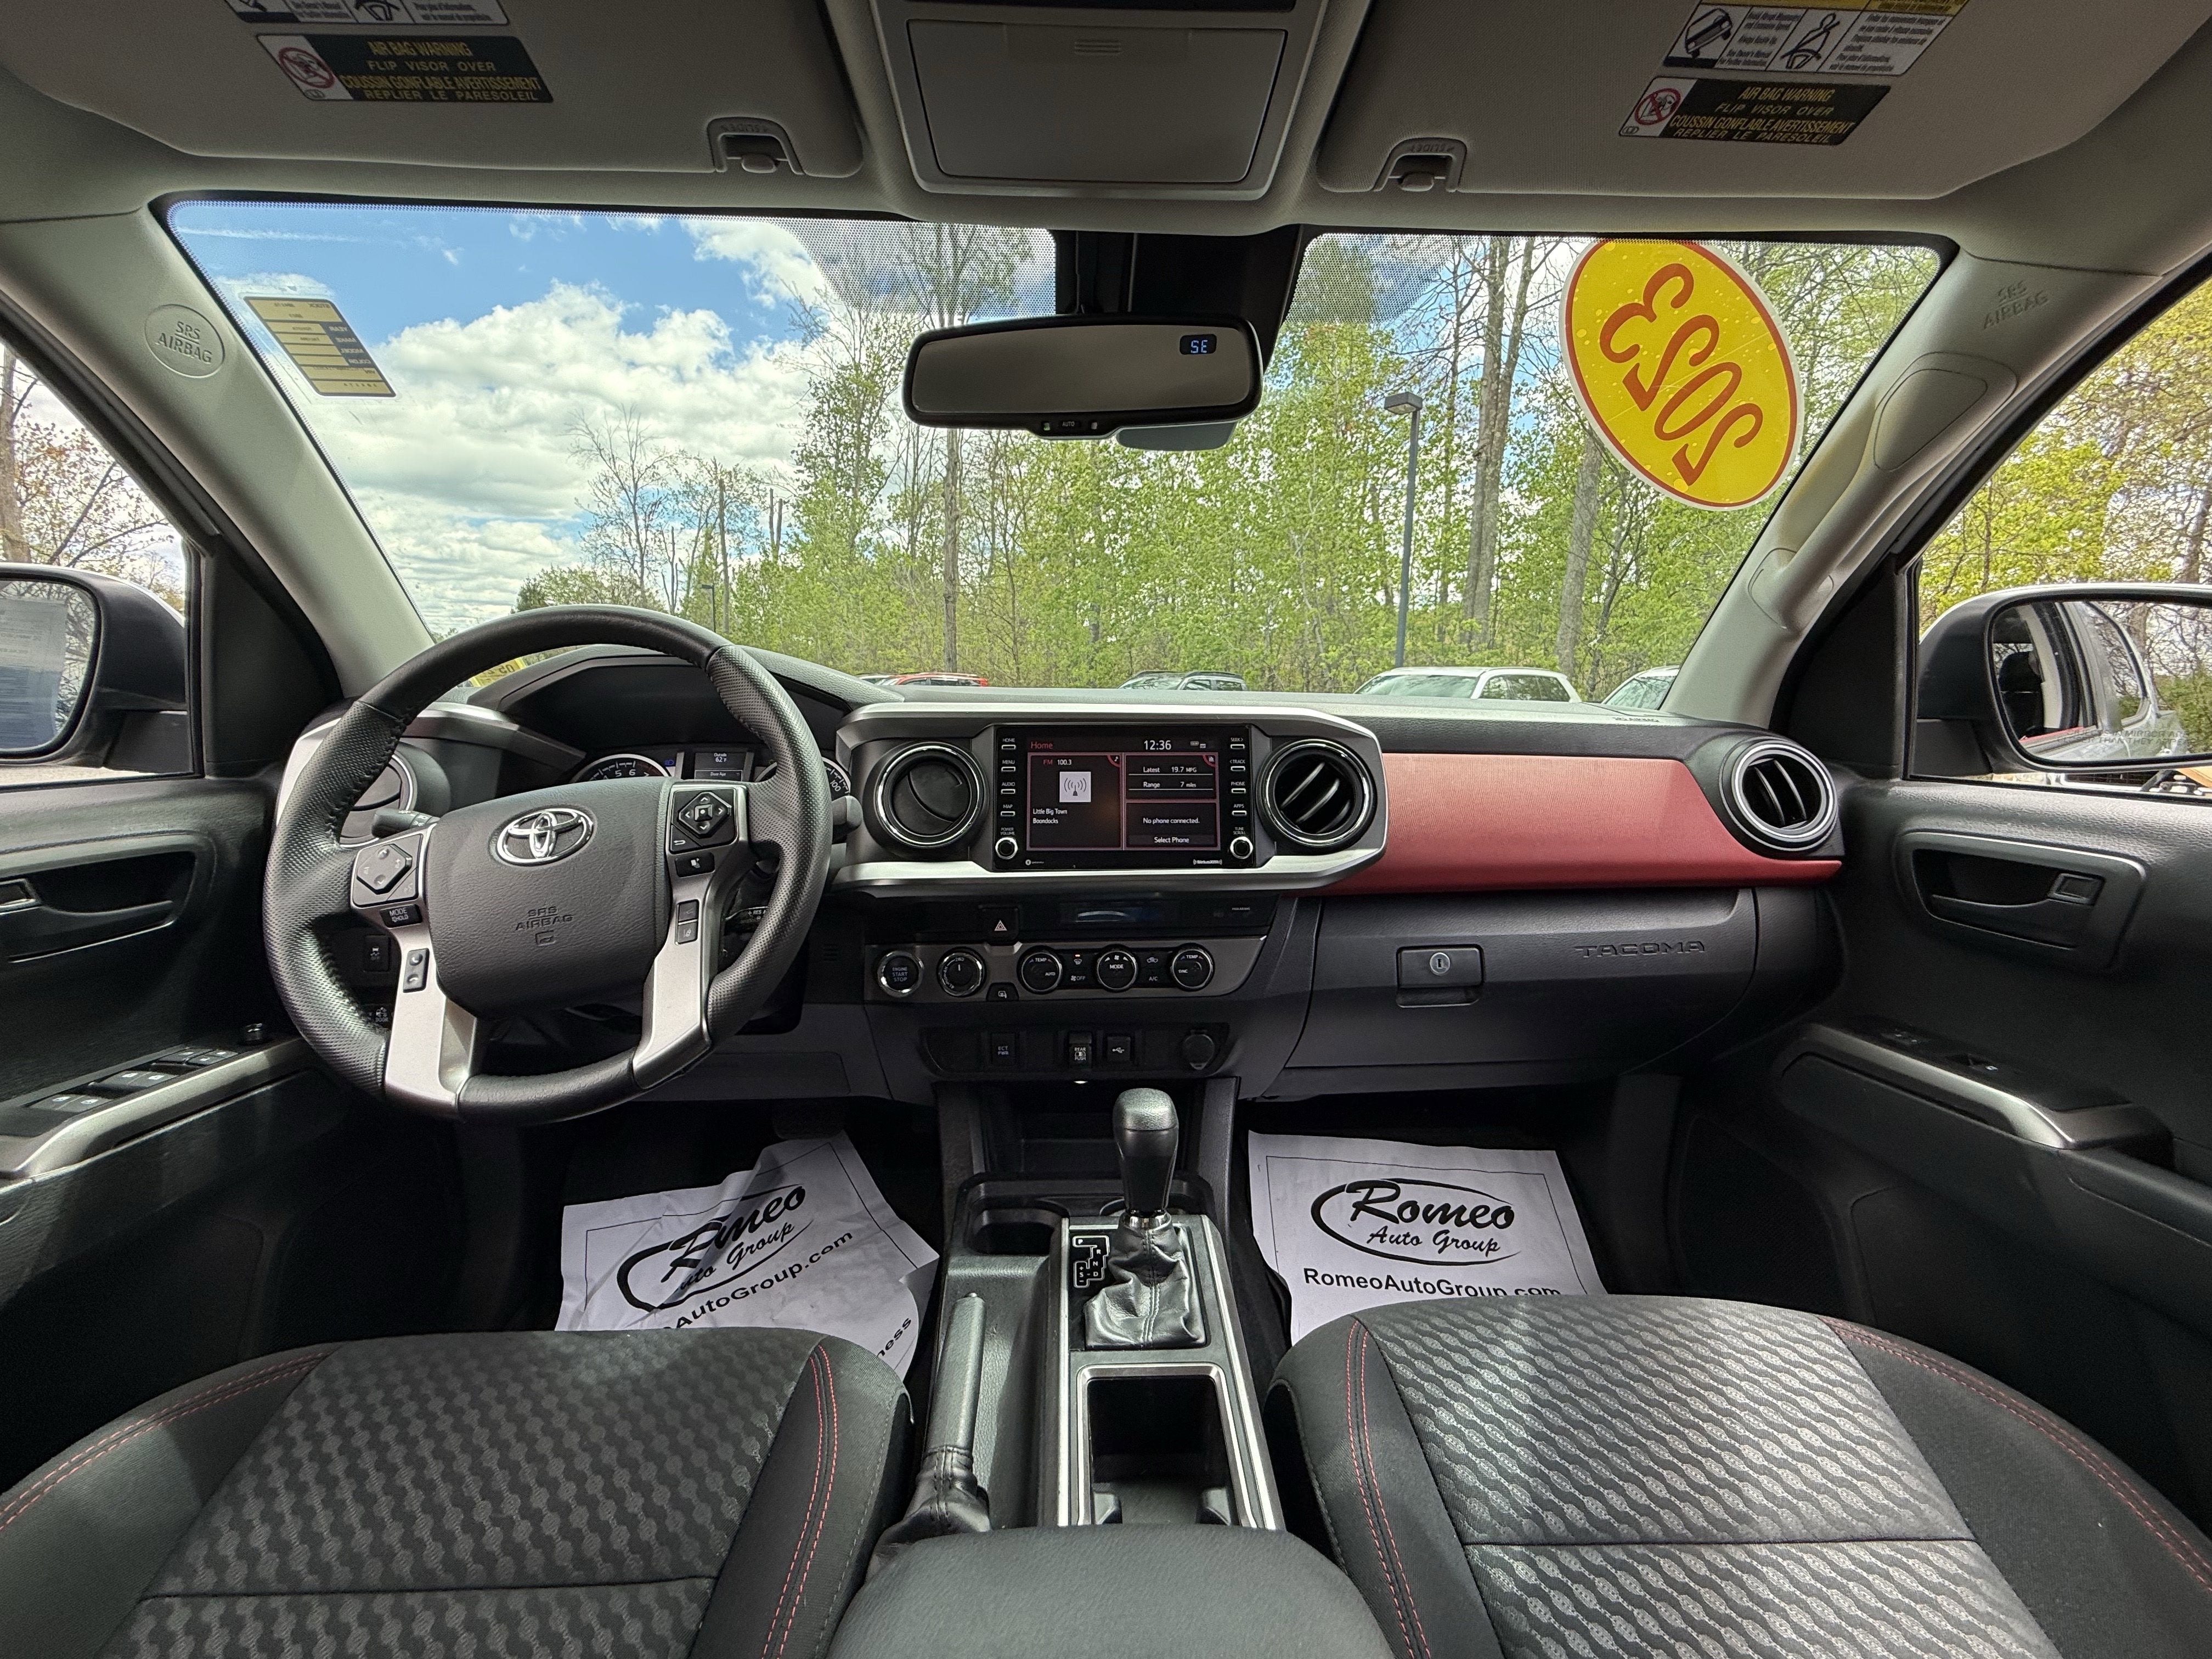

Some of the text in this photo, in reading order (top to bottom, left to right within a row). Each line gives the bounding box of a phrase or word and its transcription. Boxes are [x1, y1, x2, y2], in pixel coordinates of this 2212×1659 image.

[366, 60, 496, 72] FLIP VISOR OVER
[364, 90, 538, 101] REPLIER LE PARESOLEIL
[1737, 87, 1836, 102] AIR BAG WARNING
[1714, 103, 1834, 116] FLIP VISOR OVER
[1673, 128, 1831, 143] REPLIER LE PARESOLEIL
[1998, 280, 2028, 301] SRS
[1983, 290, 2049, 329] AIRBAG
[176, 321, 201, 340] SRS
[156, 332, 213, 364] AIRBAG
[1190, 340, 1208, 353] SE
[1144, 740, 1172, 751] 12:36
[830, 779, 842, 792] 100
[390, 907, 408, 916] MODE
[528, 906, 557, 917] SRS
[516, 914, 573, 930] AIRBAG
[1574, 940, 1705, 958] TACOMA
[1345, 1180, 1515, 1229] Romeo
[726, 1221, 795, 1271] Group
[1367, 1225, 1501, 1258] Auto Group
